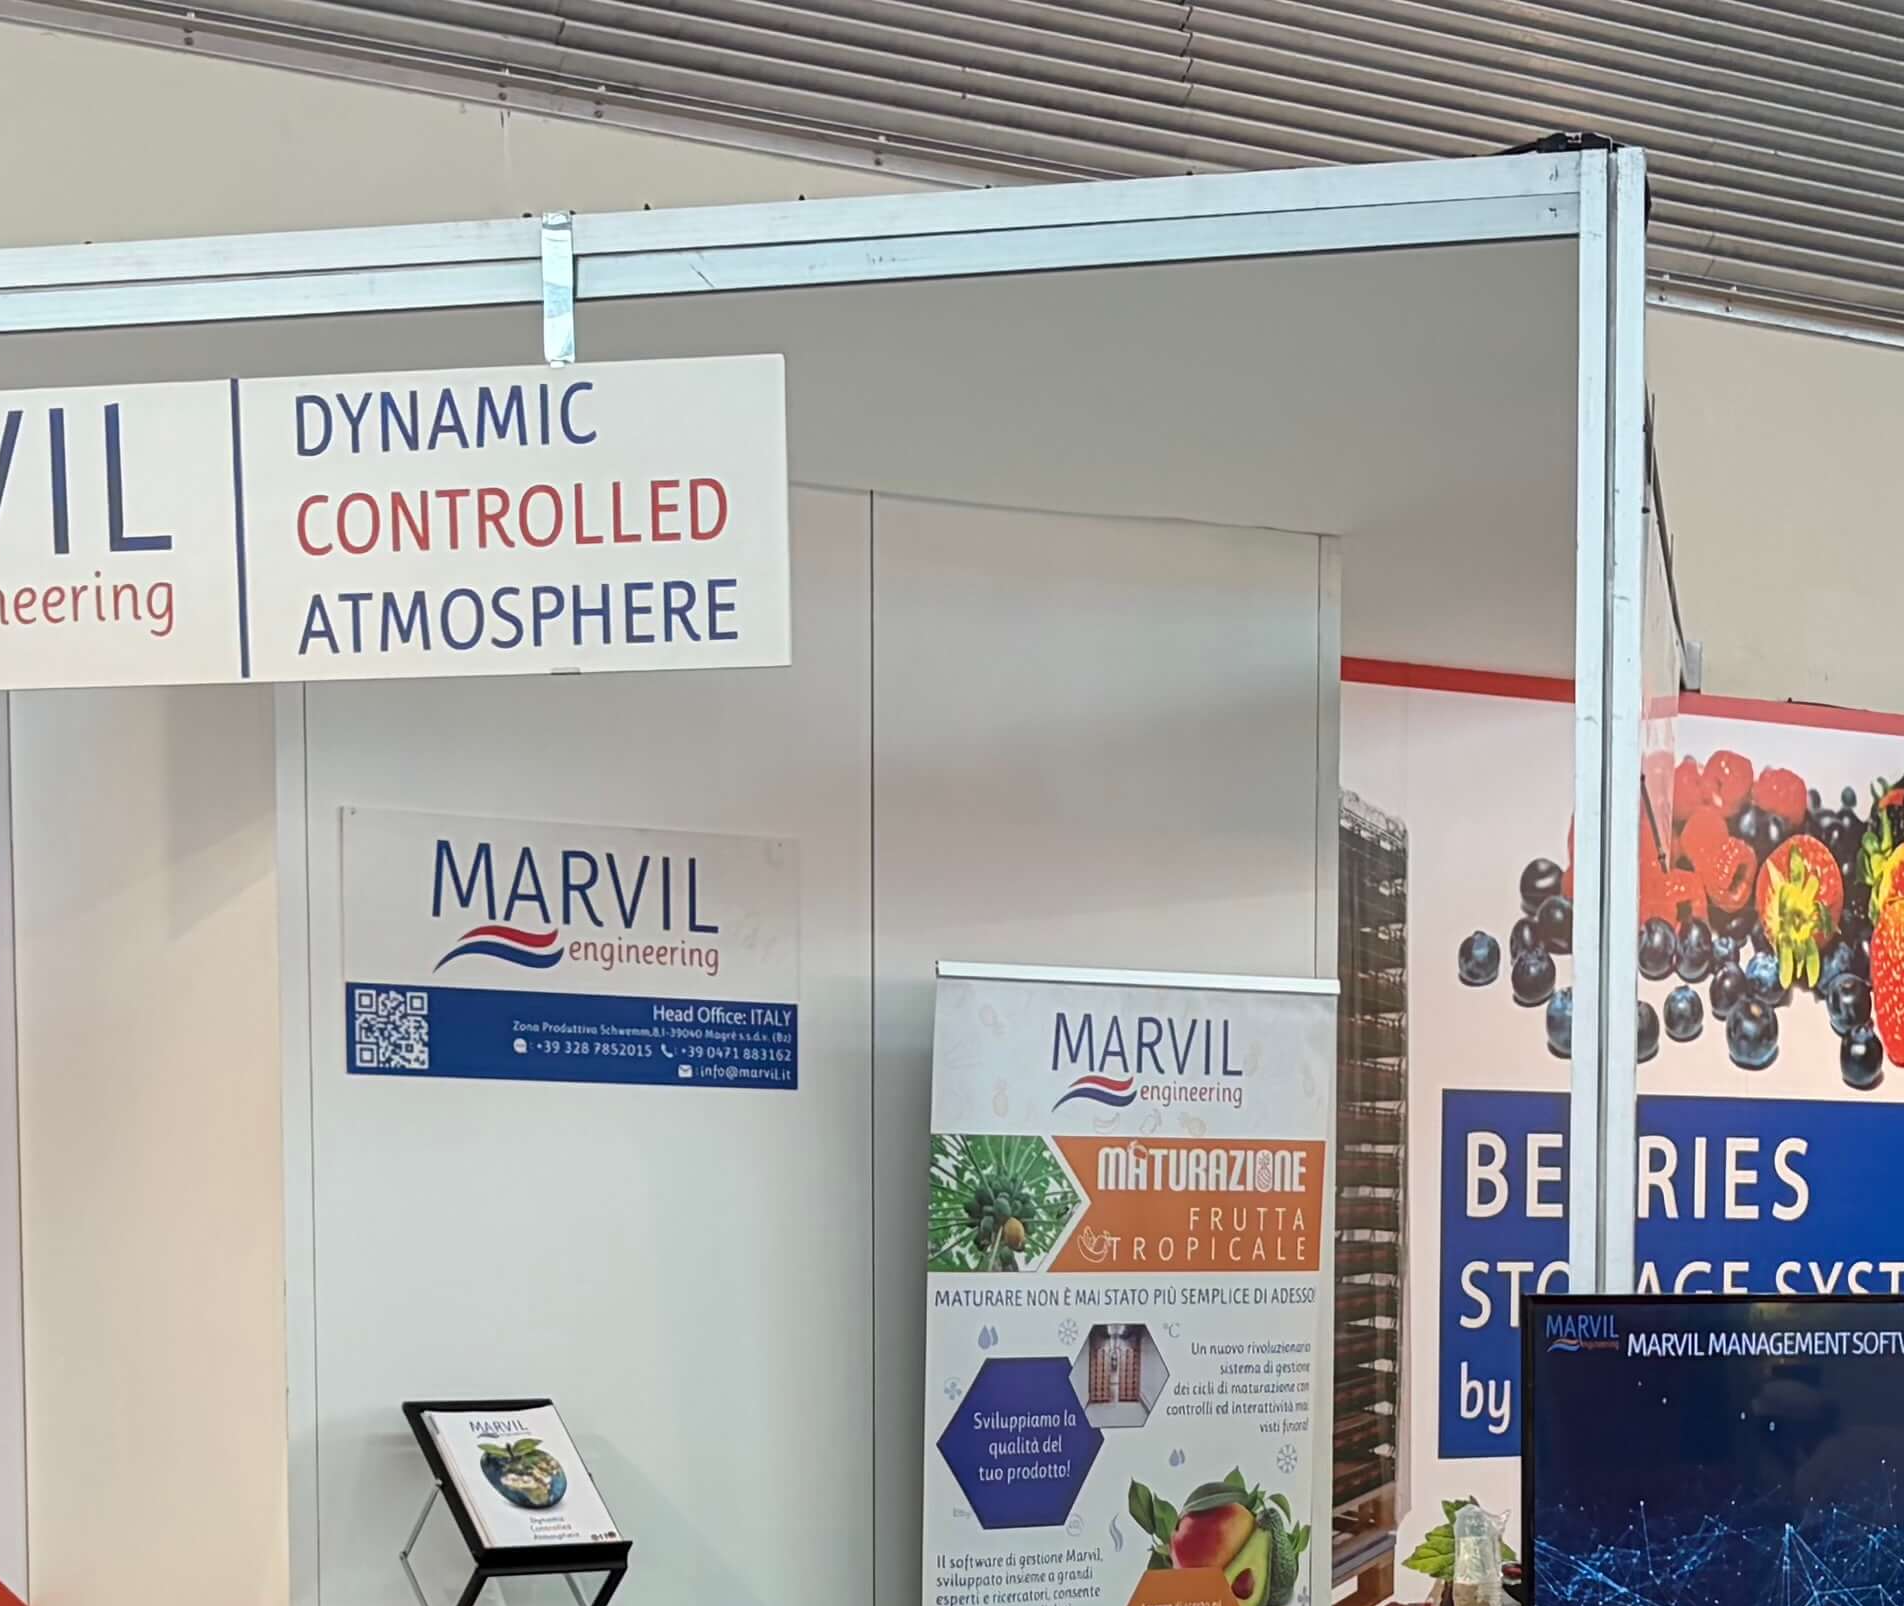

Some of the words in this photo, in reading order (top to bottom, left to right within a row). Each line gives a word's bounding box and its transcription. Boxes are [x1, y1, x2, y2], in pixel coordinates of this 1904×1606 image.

[294, 381, 598, 459] DYNAMIC
[295, 476, 730, 556] CONTROLLED
[298, 578, 741, 655] ATMOSPHERE
[431, 838, 720, 934] MARVIL
[568, 936, 720, 977] engineering
[512, 1021, 540, 1032] Zona
[653, 1005, 694, 1022] Head
[698, 1007, 747, 1024] Office:
[750, 1009, 792, 1026] ITALY
[564, 1042, 589, 1054] 328
[594, 1042, 652, 1057] 7852015
[707, 1046, 740, 1060] 0471
[743, 1048, 792, 1062] 883162
[1051, 1012, 1244, 1077] MARVIL
[1140, 1081, 1242, 1109] engineering
[1097, 1146, 1307, 1193] MATURAZIONE
[1464, 1130, 1809, 1220] BERIES
[1189, 1207, 1306, 1232] FRUTTA
[1110, 1236, 1306, 1262] TROPICALE
[935, 1289, 1024, 1308] MATURARE
[1027, 1289, 1060, 1306] NON
[1064, 1284, 1072, 1305] È
[1075, 1288, 1103, 1306] MAI
[1104, 1288, 1149, 1305] STATO
[1153, 1284, 1177, 1306] PIÙ
[1181, 1287, 1250, 1305] SEMPLICE
[1253, 1288, 1268, 1305] DI
[1546, 1314, 1619, 1338] MARVIL
[1191, 1342, 1206, 1355] Un
[1210, 1345, 1244, 1355] nuovo
[1627, 1333, 1704, 1357] MARVIL
[1708, 1331, 1850, 1356] MANAGEMENT
[1220, 1363, 1260, 1375] sistema
[1264, 1362, 1273, 1374] di
[1217, 1381, 1228, 1394] di
[1460, 1362, 1512, 1435] by
[974, 1411, 1060, 1432] Sviluppiamo
[1064, 1409, 1076, 1426] la
[1167, 1402, 1212, 1415] controlli
[1216, 1402, 1228, 1415] ed
[469, 1420, 528, 1434] MARVIL
[988, 1437, 1039, 1458] qualità
[1043, 1435, 1062, 1453] del
[979, 1466, 1003, 1481] tuo
[1007, 1460, 1071, 1484] prodotto!
[950, 1554, 1003, 1570] software
[1006, 1552, 1016, 1566] di
[936, 1574, 1002, 1590] sviluppato
[1057, 1568, 1093, 1584] grandi
[983, 1595, 989, 1604] e
[1053, 1586, 1100, 1600] consente
